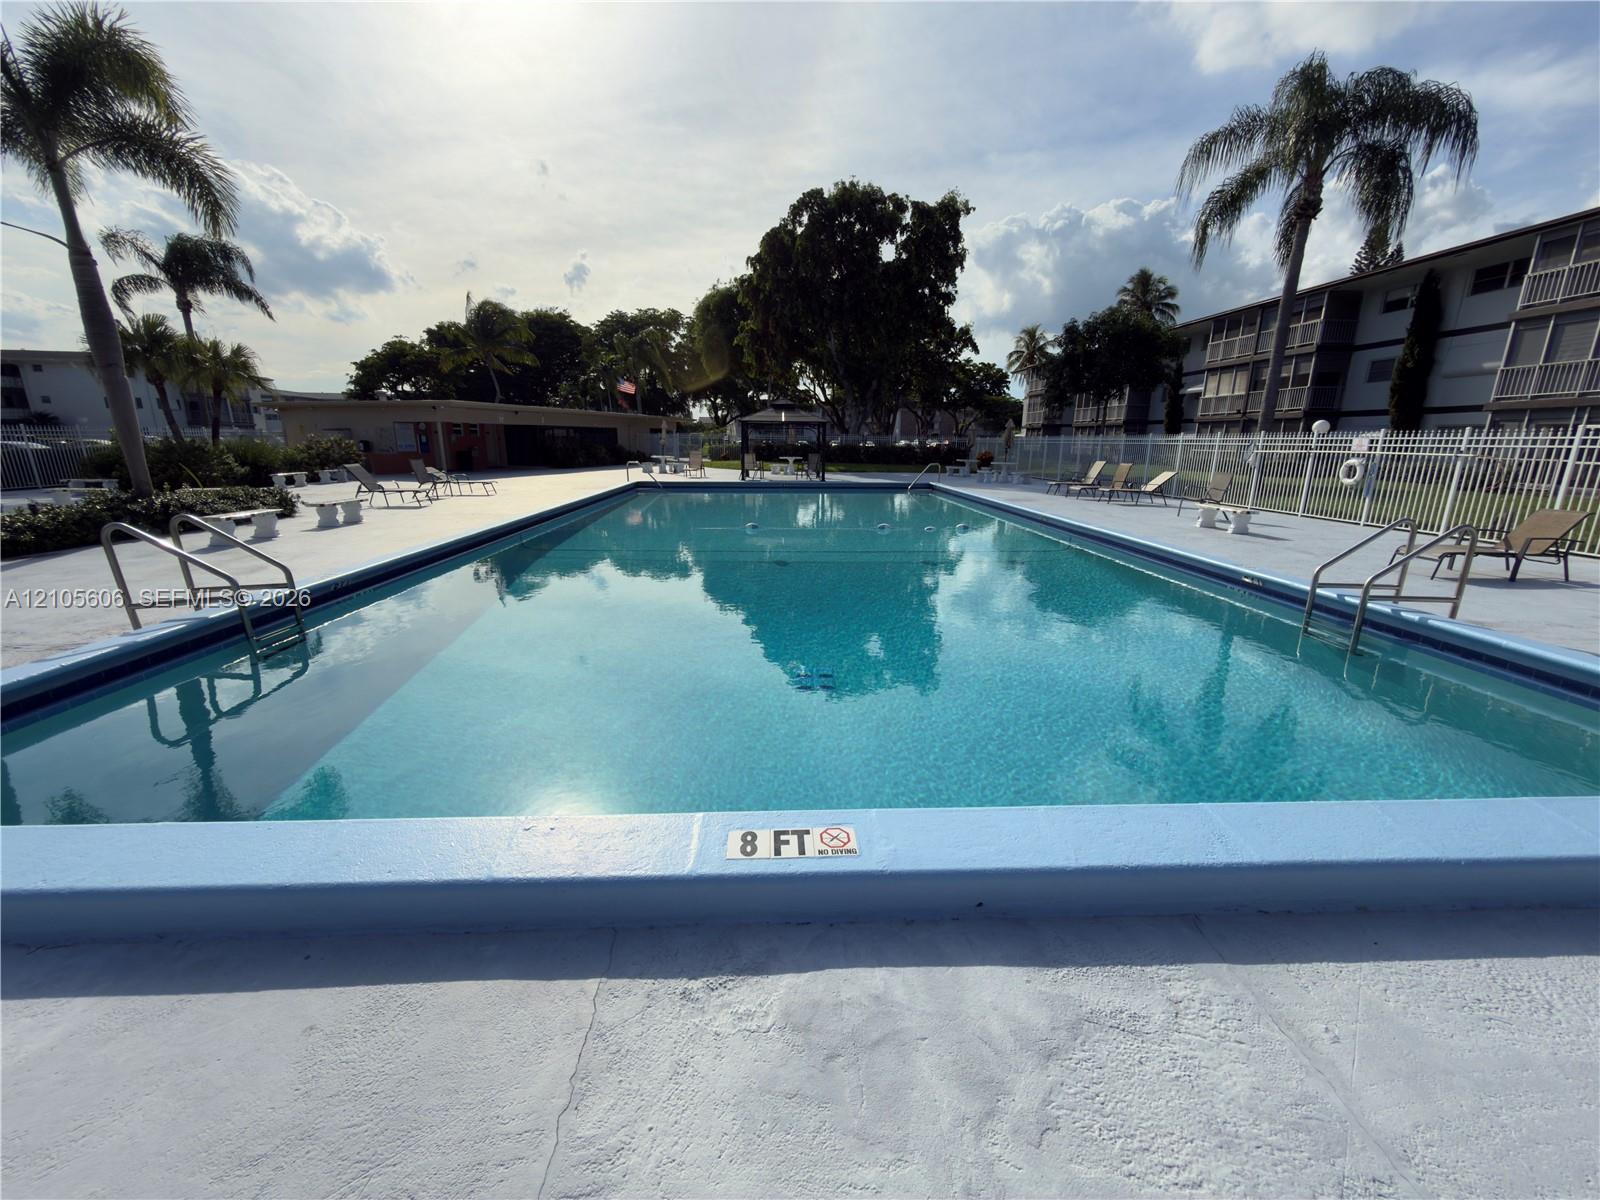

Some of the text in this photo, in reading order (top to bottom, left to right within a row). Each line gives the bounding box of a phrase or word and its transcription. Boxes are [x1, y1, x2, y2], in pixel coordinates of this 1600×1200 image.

[740, 829, 811, 857] 8 FT
[831, 848, 858, 856] DIVING
